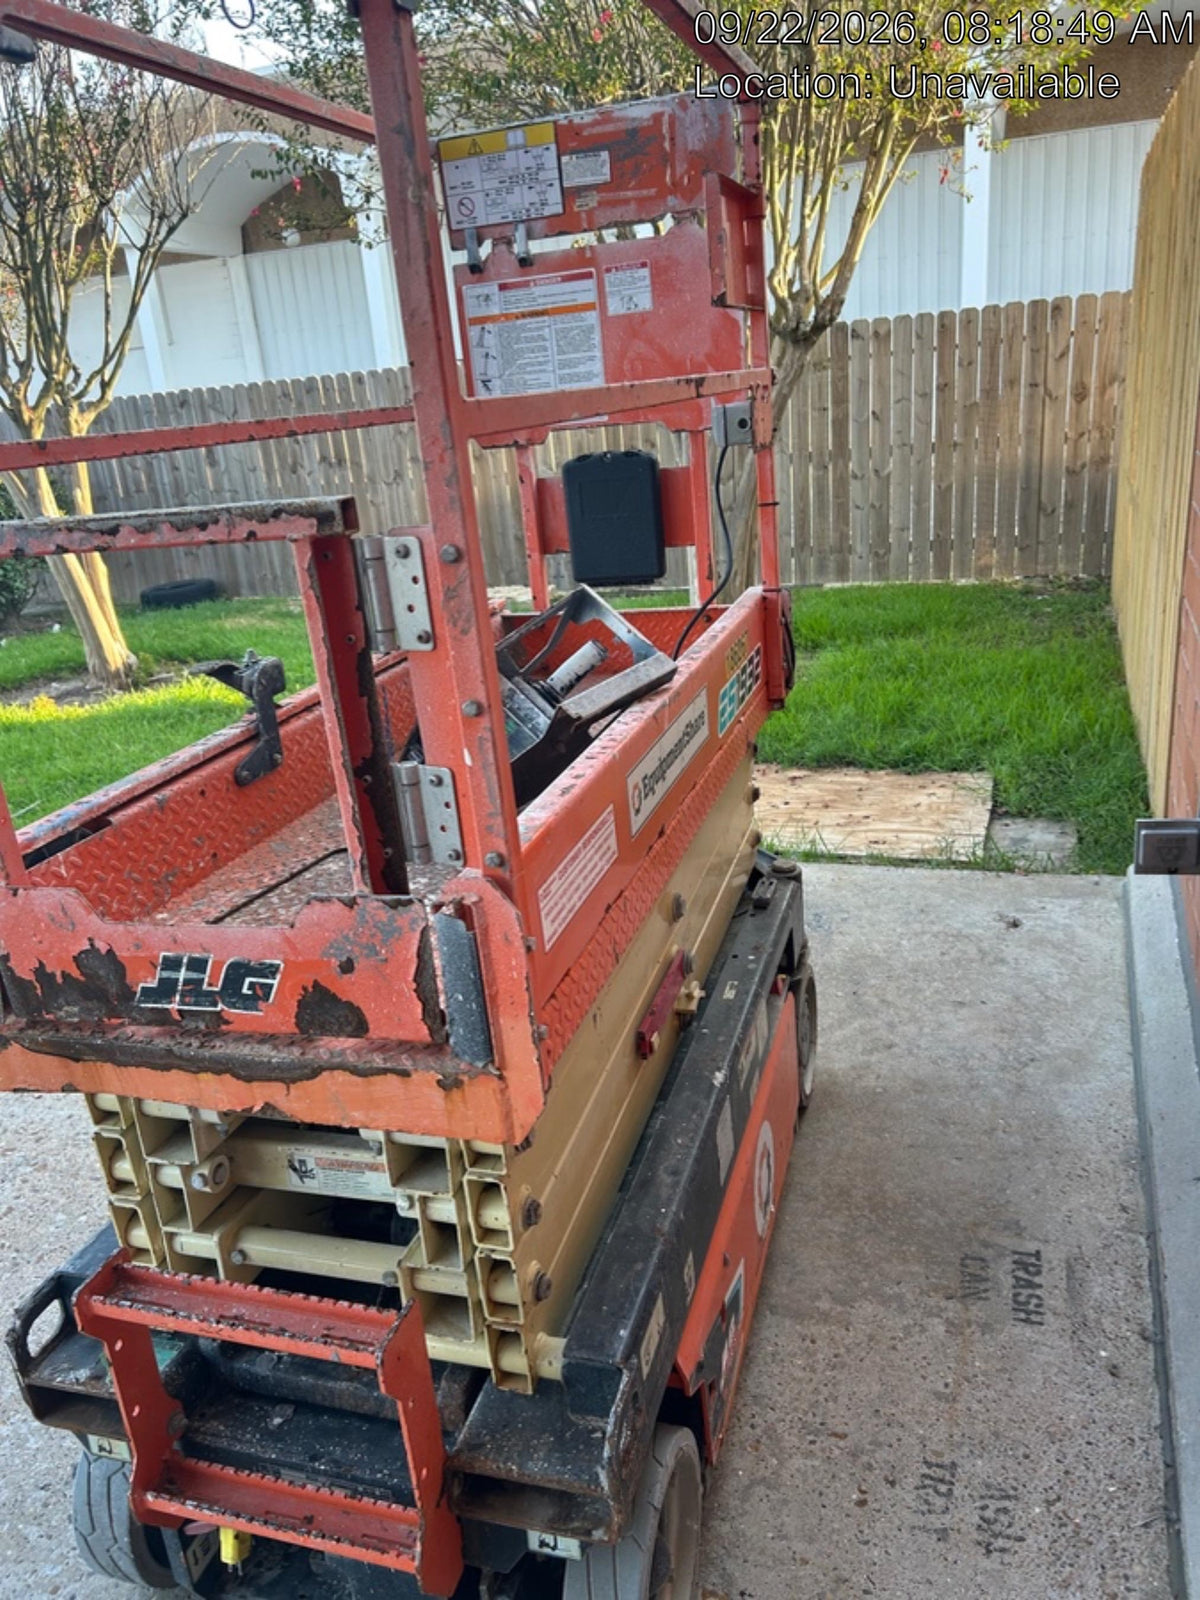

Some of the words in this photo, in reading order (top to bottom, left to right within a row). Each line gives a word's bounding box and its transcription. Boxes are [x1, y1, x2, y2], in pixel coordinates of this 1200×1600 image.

[135, 951, 285, 1016] JLG
[959, 1253, 991, 1302] CAN
[1011, 1248, 1047, 1327] TRASH
